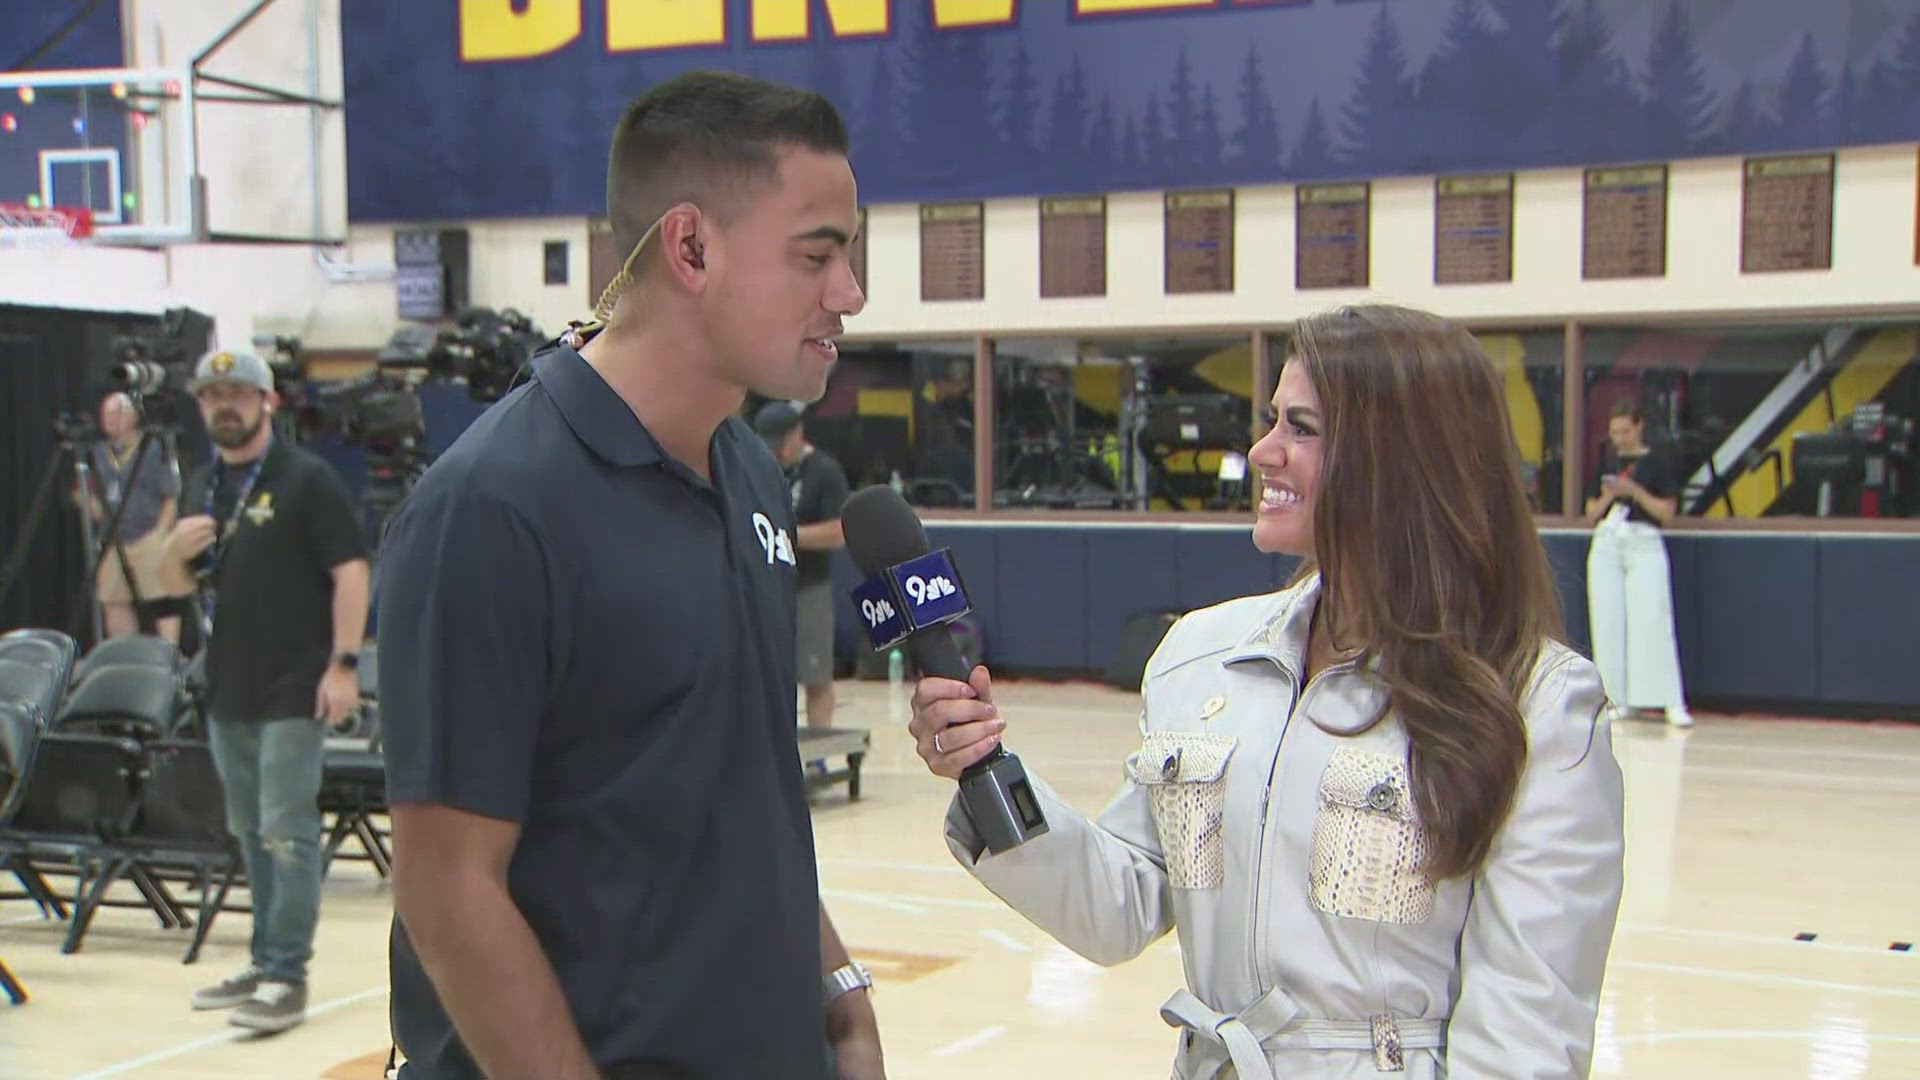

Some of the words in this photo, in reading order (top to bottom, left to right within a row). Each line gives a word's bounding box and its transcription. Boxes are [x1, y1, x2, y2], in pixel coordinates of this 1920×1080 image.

[752, 512, 775, 564] 9
[905, 575, 926, 607] 9
[861, 599, 876, 628] 9
